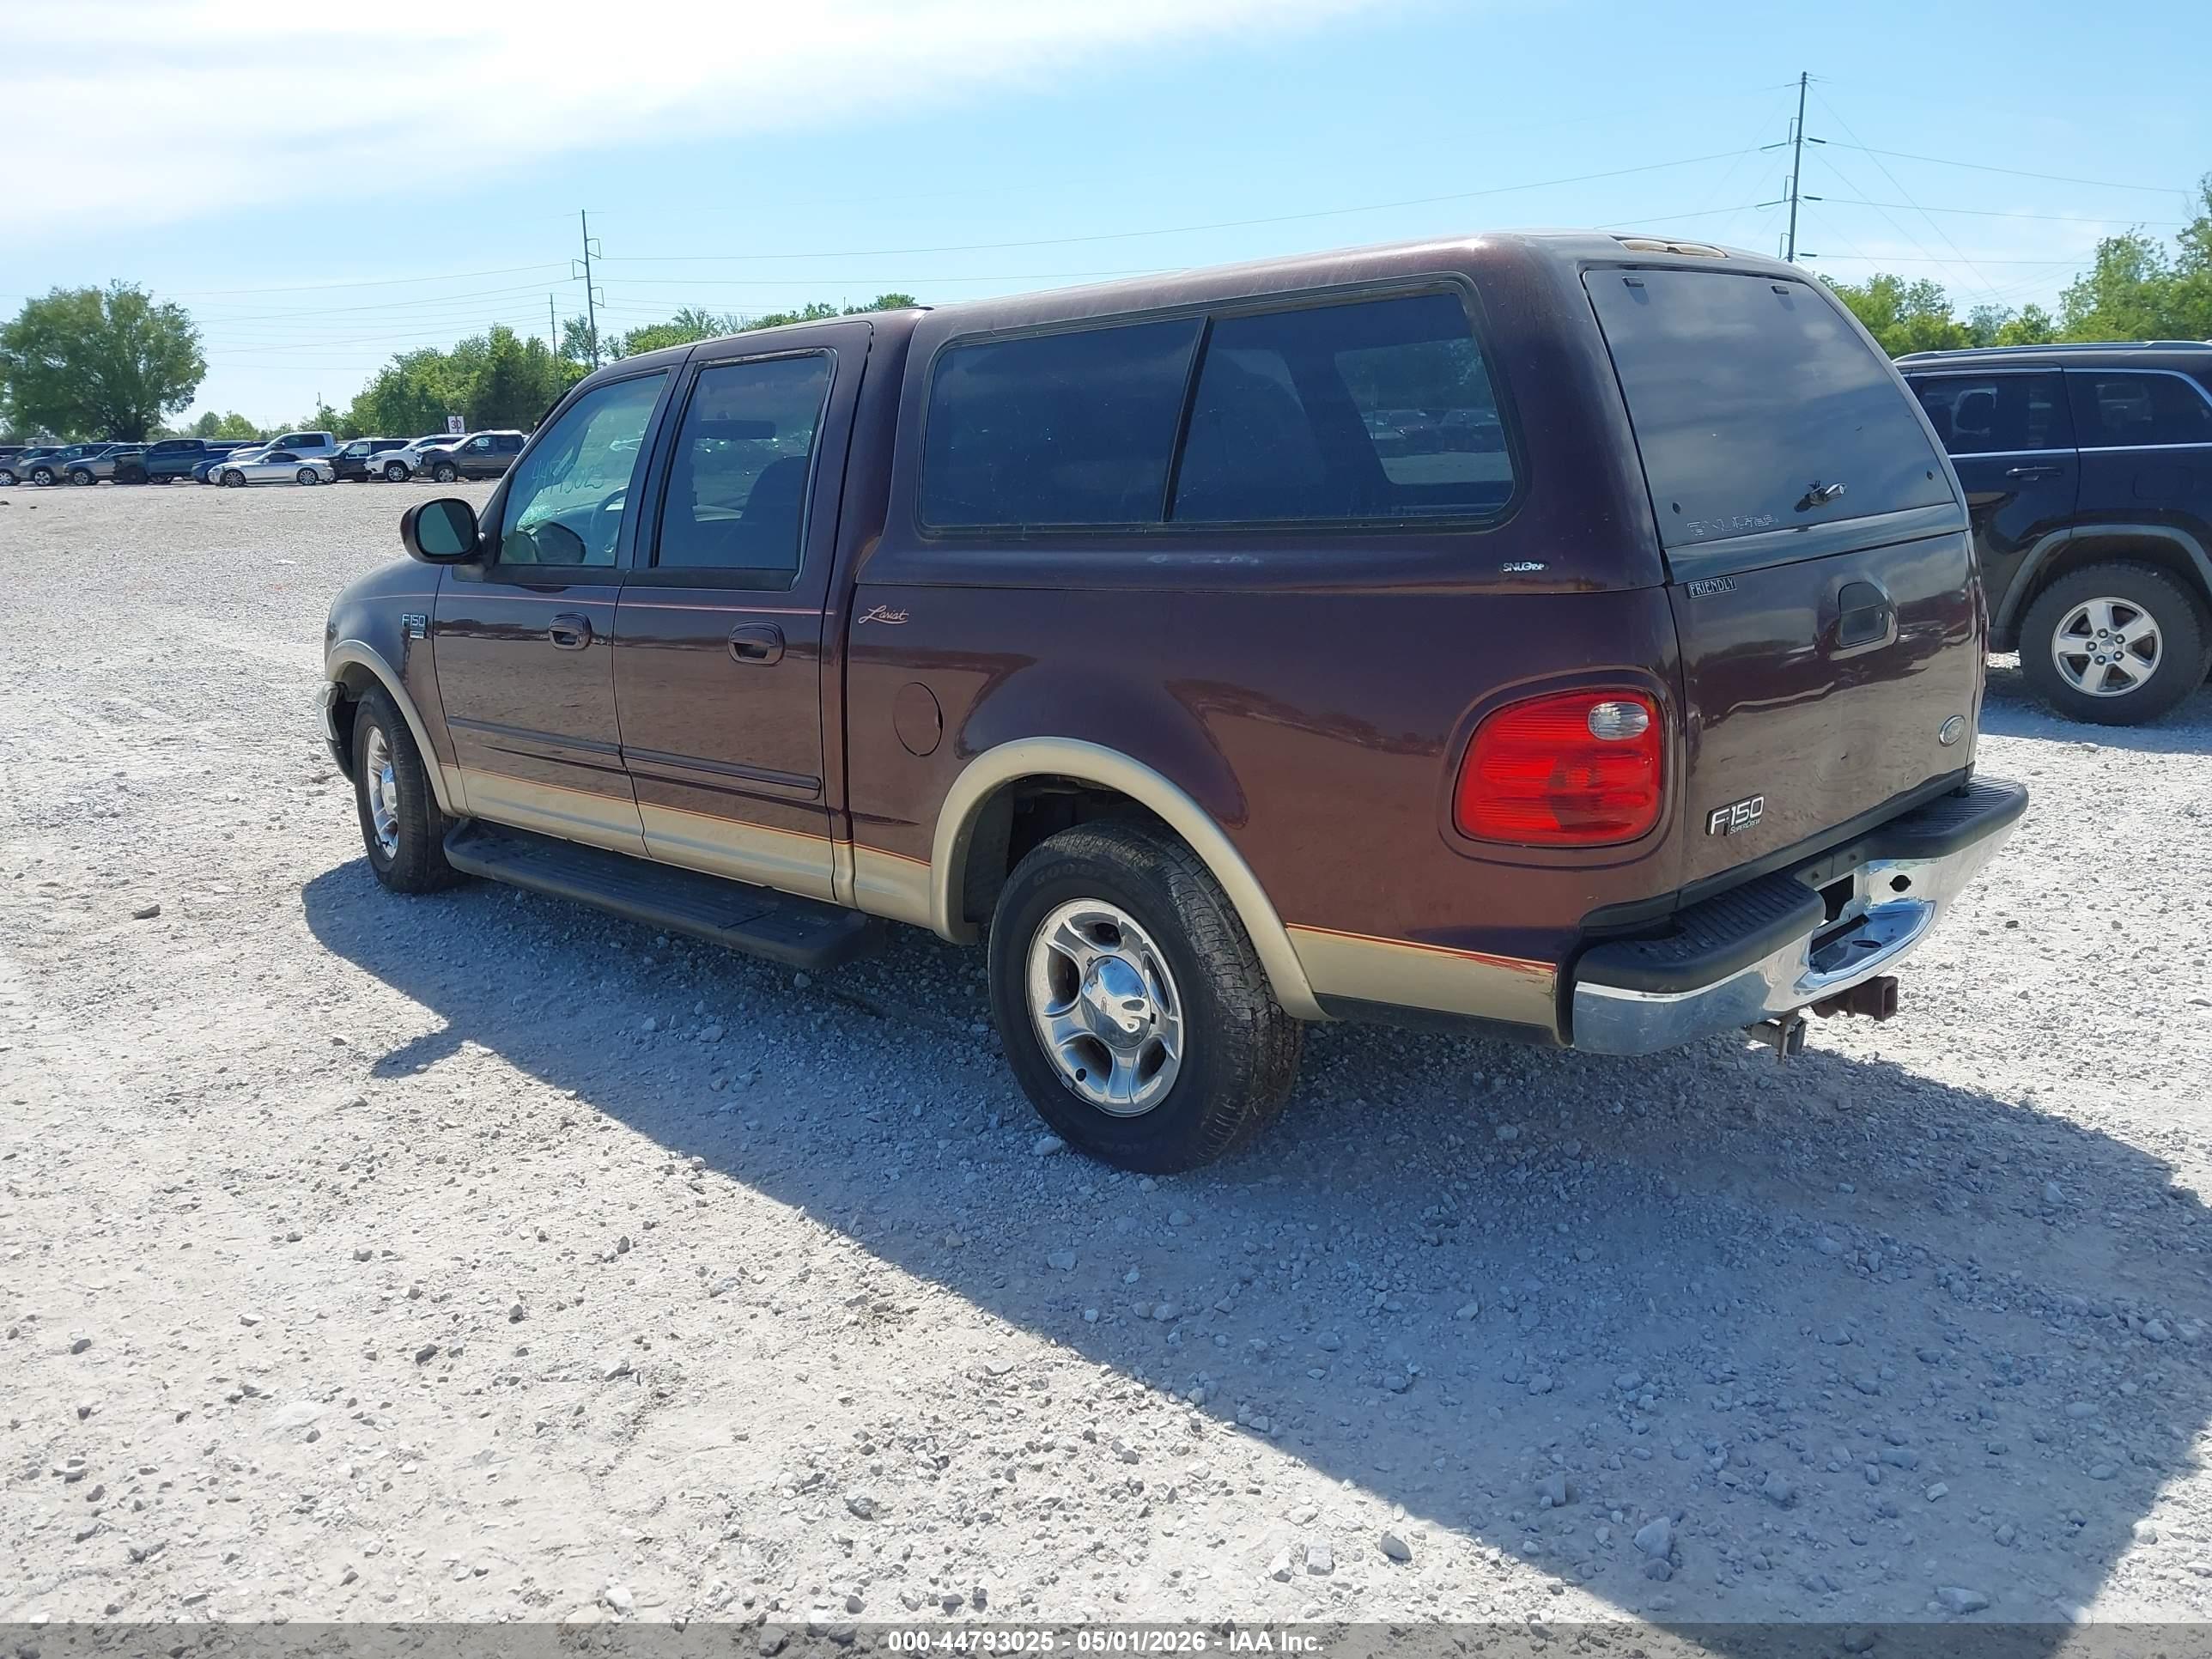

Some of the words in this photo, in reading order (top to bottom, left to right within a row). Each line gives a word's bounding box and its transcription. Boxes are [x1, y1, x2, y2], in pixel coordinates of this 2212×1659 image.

[451, 420, 462, 429] 30
[1688, 576, 1736, 597] FRIENDLY
[859, 605, 909, 624] Lariat
